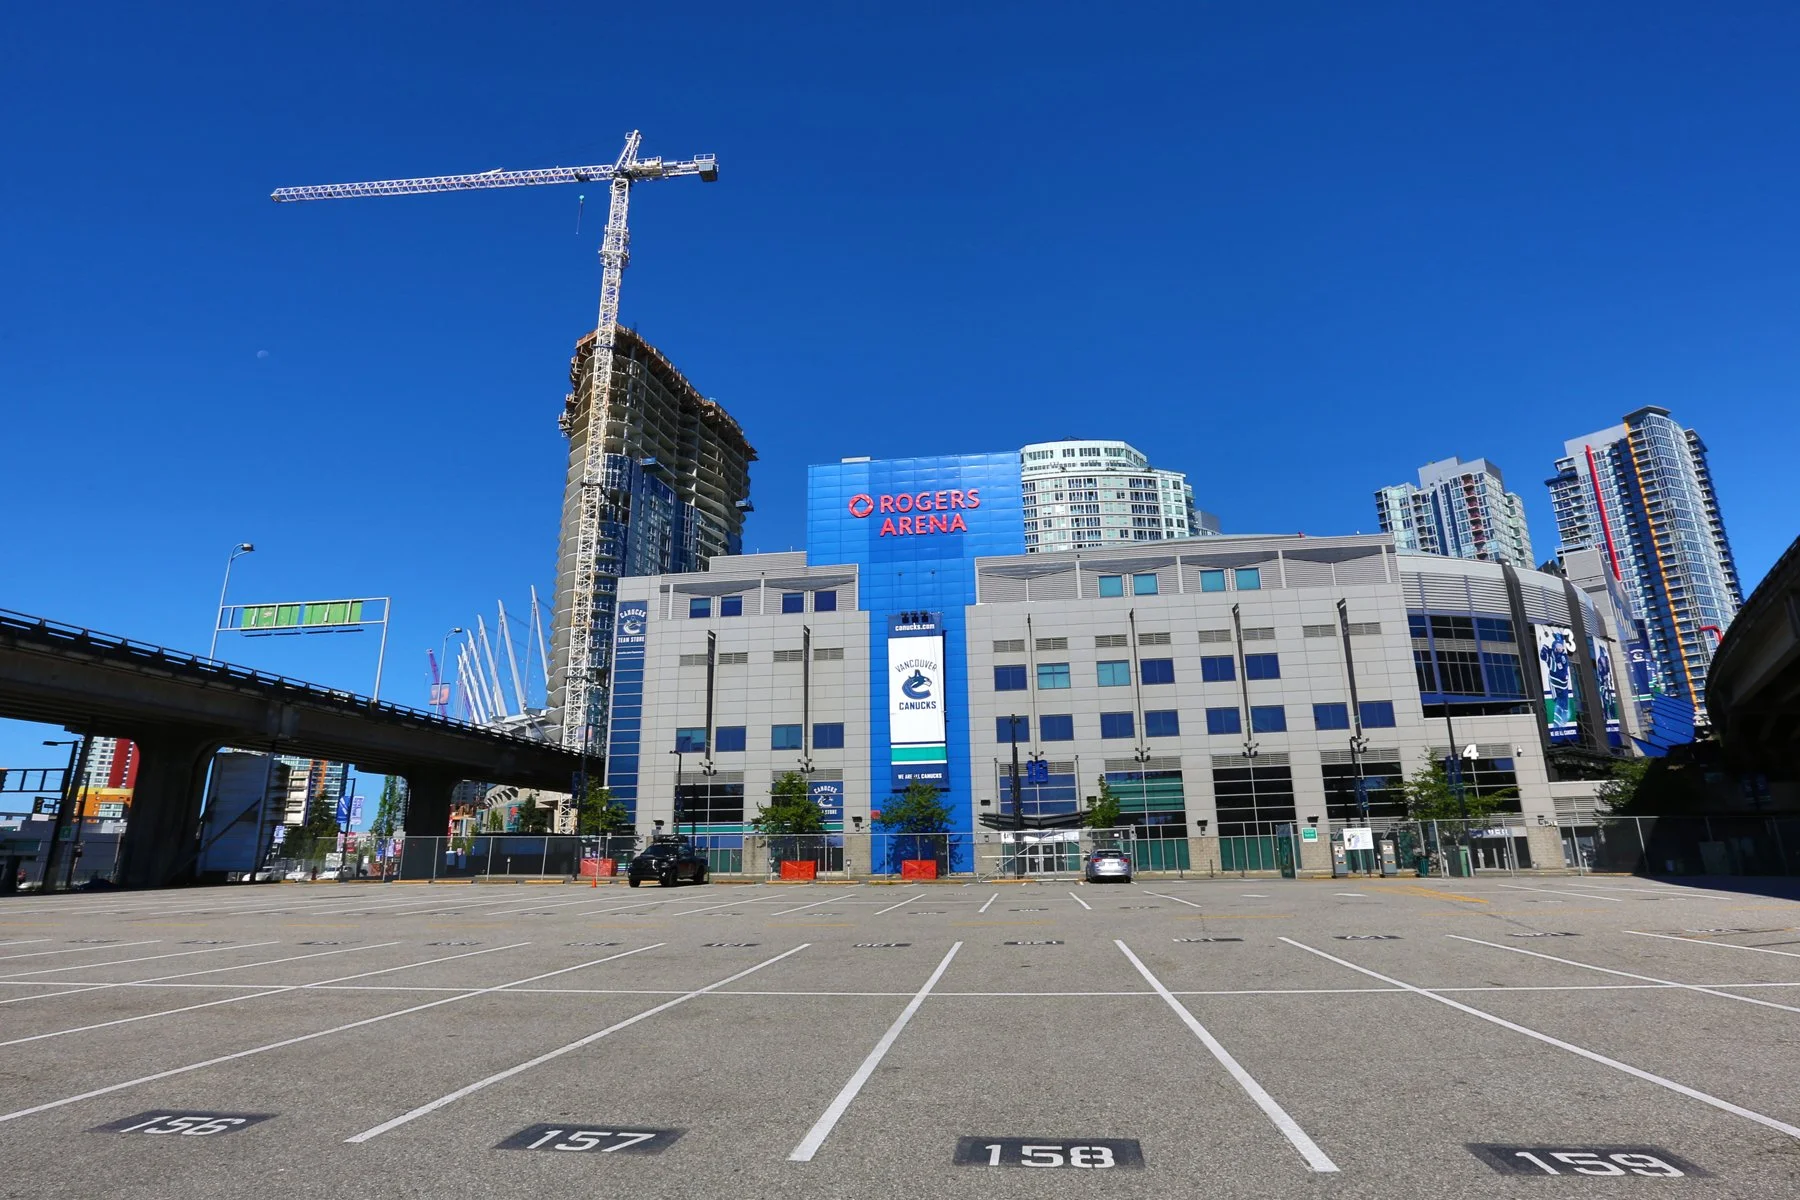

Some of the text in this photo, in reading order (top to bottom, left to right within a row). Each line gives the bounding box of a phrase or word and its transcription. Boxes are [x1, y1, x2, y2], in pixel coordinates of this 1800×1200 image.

[879, 488, 981, 514] ROGERS
[879, 512, 968, 537] ARENA
[620, 608, 646, 619] CANUCKS
[894, 622, 936, 632] canucks.com
[894, 658, 939, 673] VANCOUVER
[898, 700, 937, 711] CANUCKS
[1462, 743, 1479, 760] 4
[813, 785, 837, 794] CANUCKS
[119, 1115, 246, 1137] 156
[526, 1129, 657, 1153] 157
[984, 1143, 1116, 1169] 158
[1514, 1151, 1686, 1178] 159
